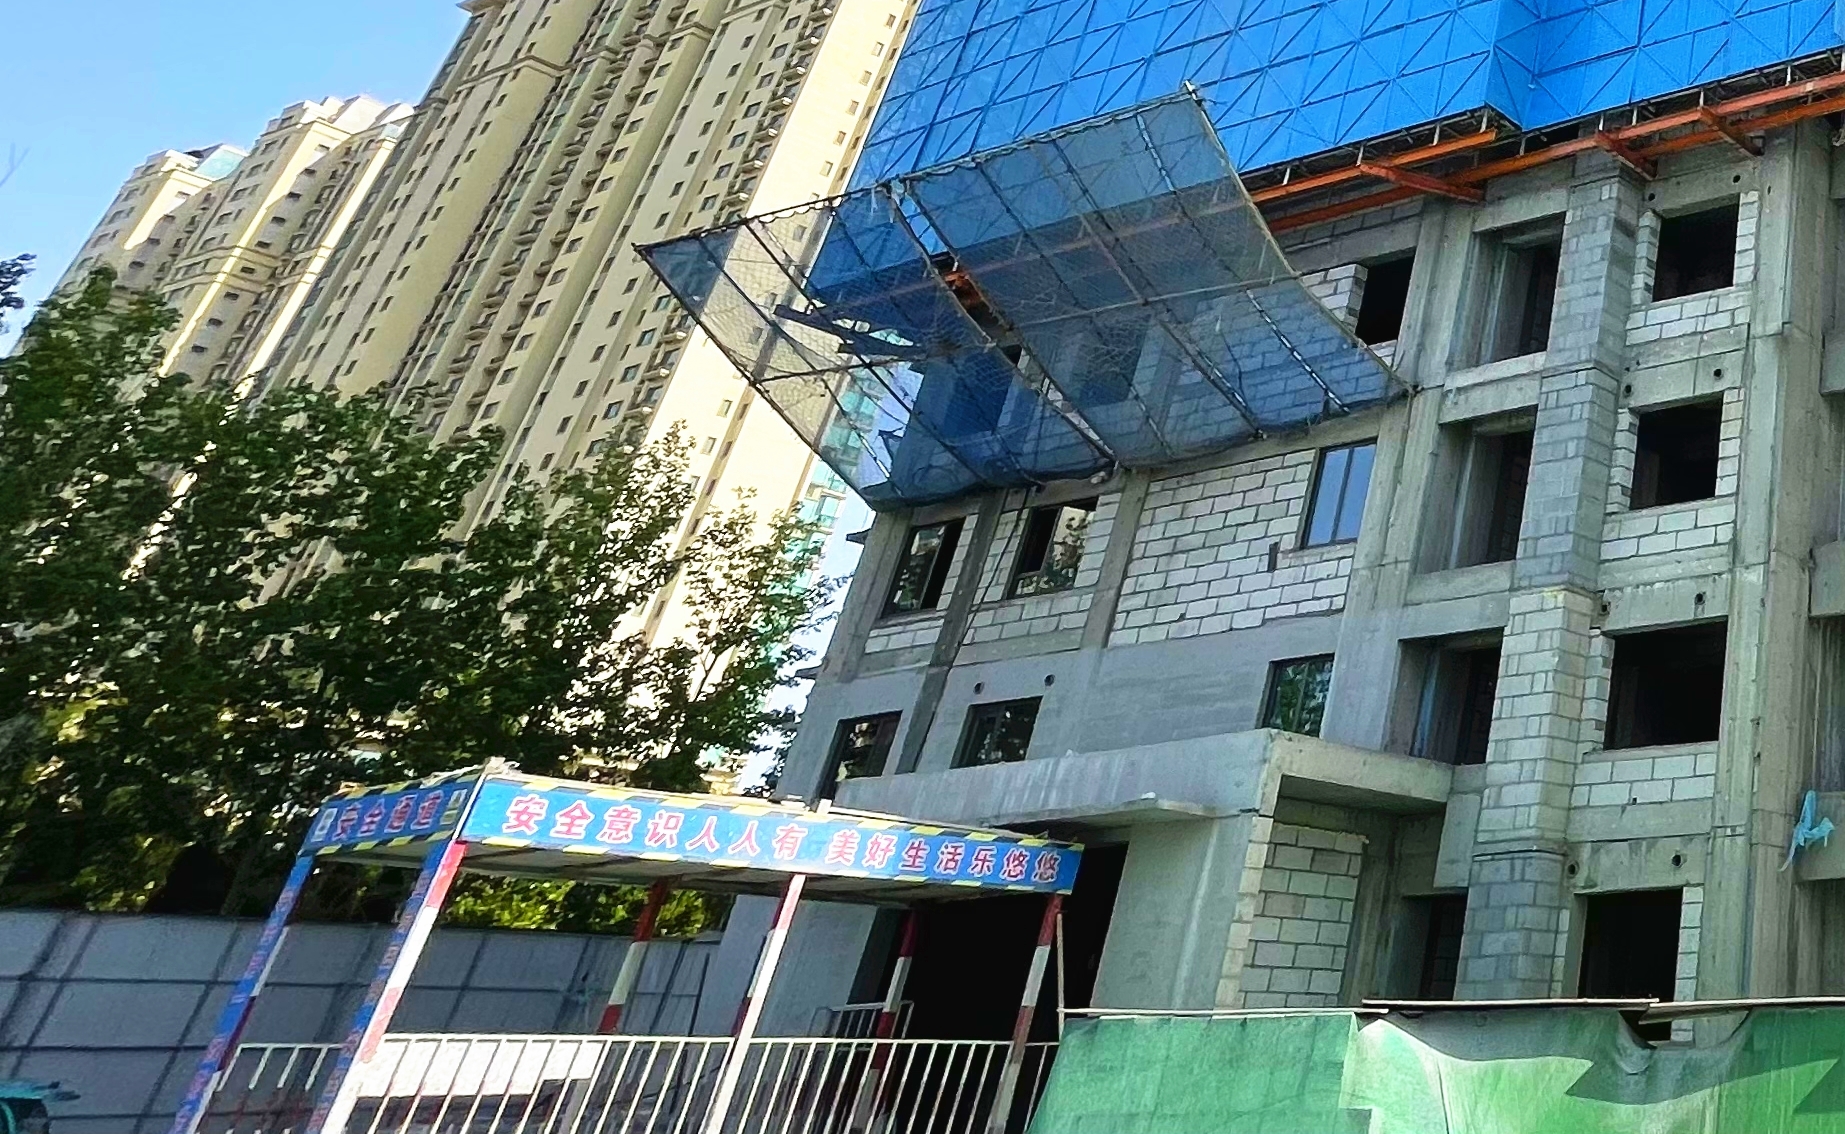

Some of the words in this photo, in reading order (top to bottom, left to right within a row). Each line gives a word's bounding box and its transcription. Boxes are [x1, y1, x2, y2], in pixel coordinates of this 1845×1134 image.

[332, 789, 445, 841] 安全通道
[503, 794, 808, 860] 安全意识人人有
[828, 830, 1061, 883] 美好生活乐悠悠
